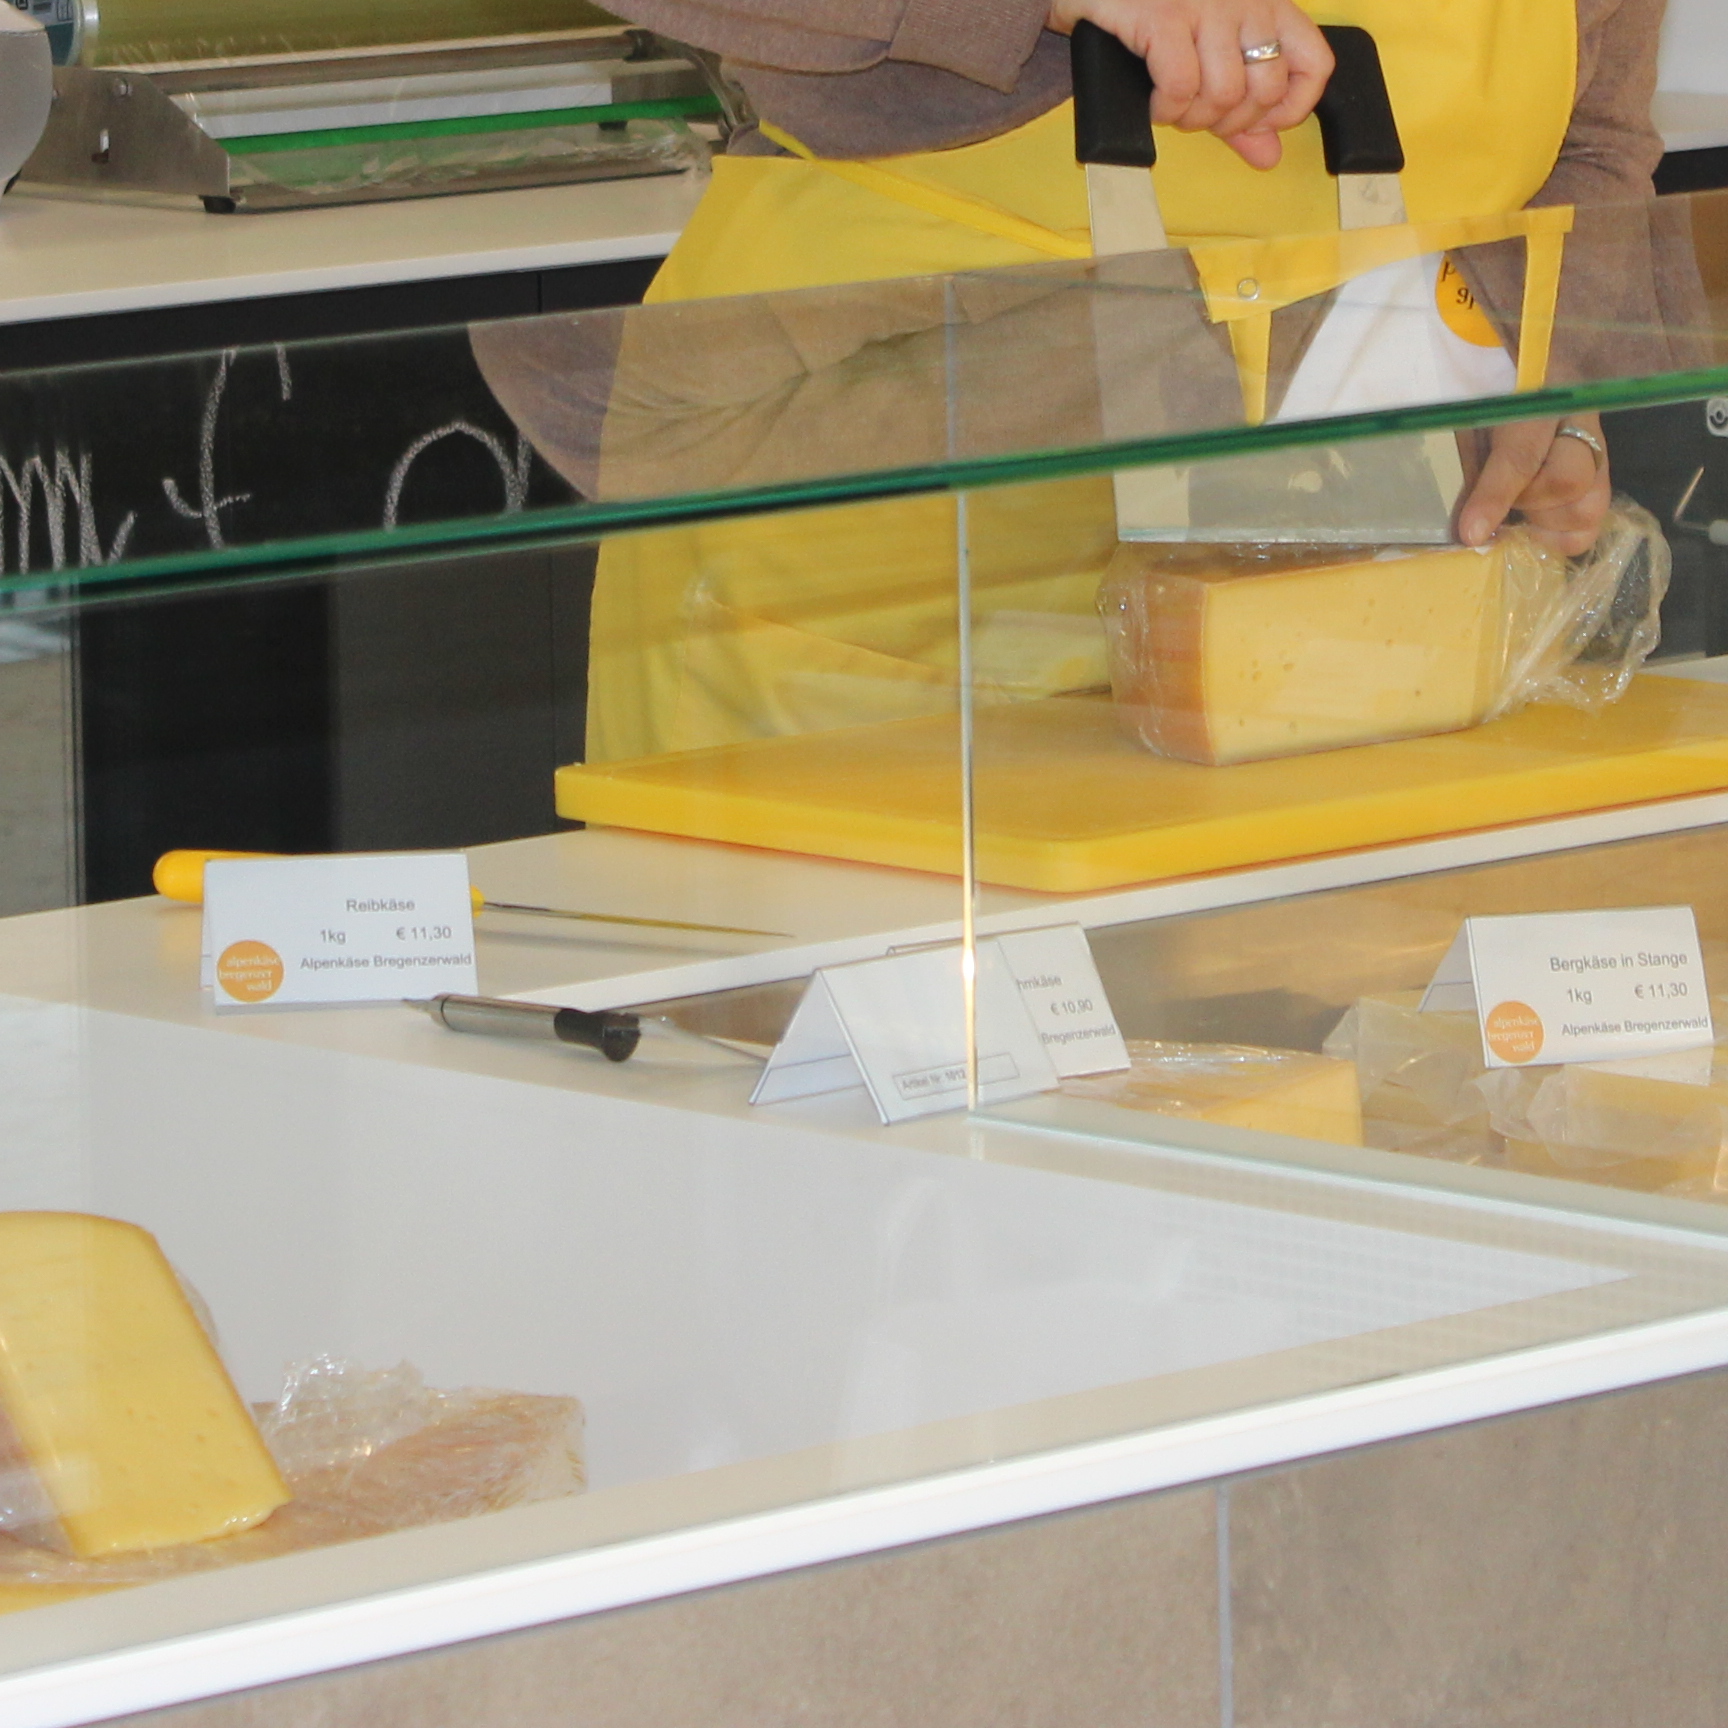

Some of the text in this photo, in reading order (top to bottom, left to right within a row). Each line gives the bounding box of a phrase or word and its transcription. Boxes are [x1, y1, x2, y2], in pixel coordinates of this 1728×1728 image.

[345, 898, 415, 913] Reibkäse
[320, 925, 452, 945] 1kg € 11,30
[300, 952, 472, 972] Alpenkäse Bregenzerwald
[1550, 951, 1688, 974] Bergkäse in Stange
[1566, 981, 1688, 1005] 1kg € 11,30
[1050, 998, 1094, 1016] € 10,90
[1041, 1023, 1117, 1047] Bregenzerwald
[1561, 1016, 1709, 1038] Alpenkäse Bregenzerwald
